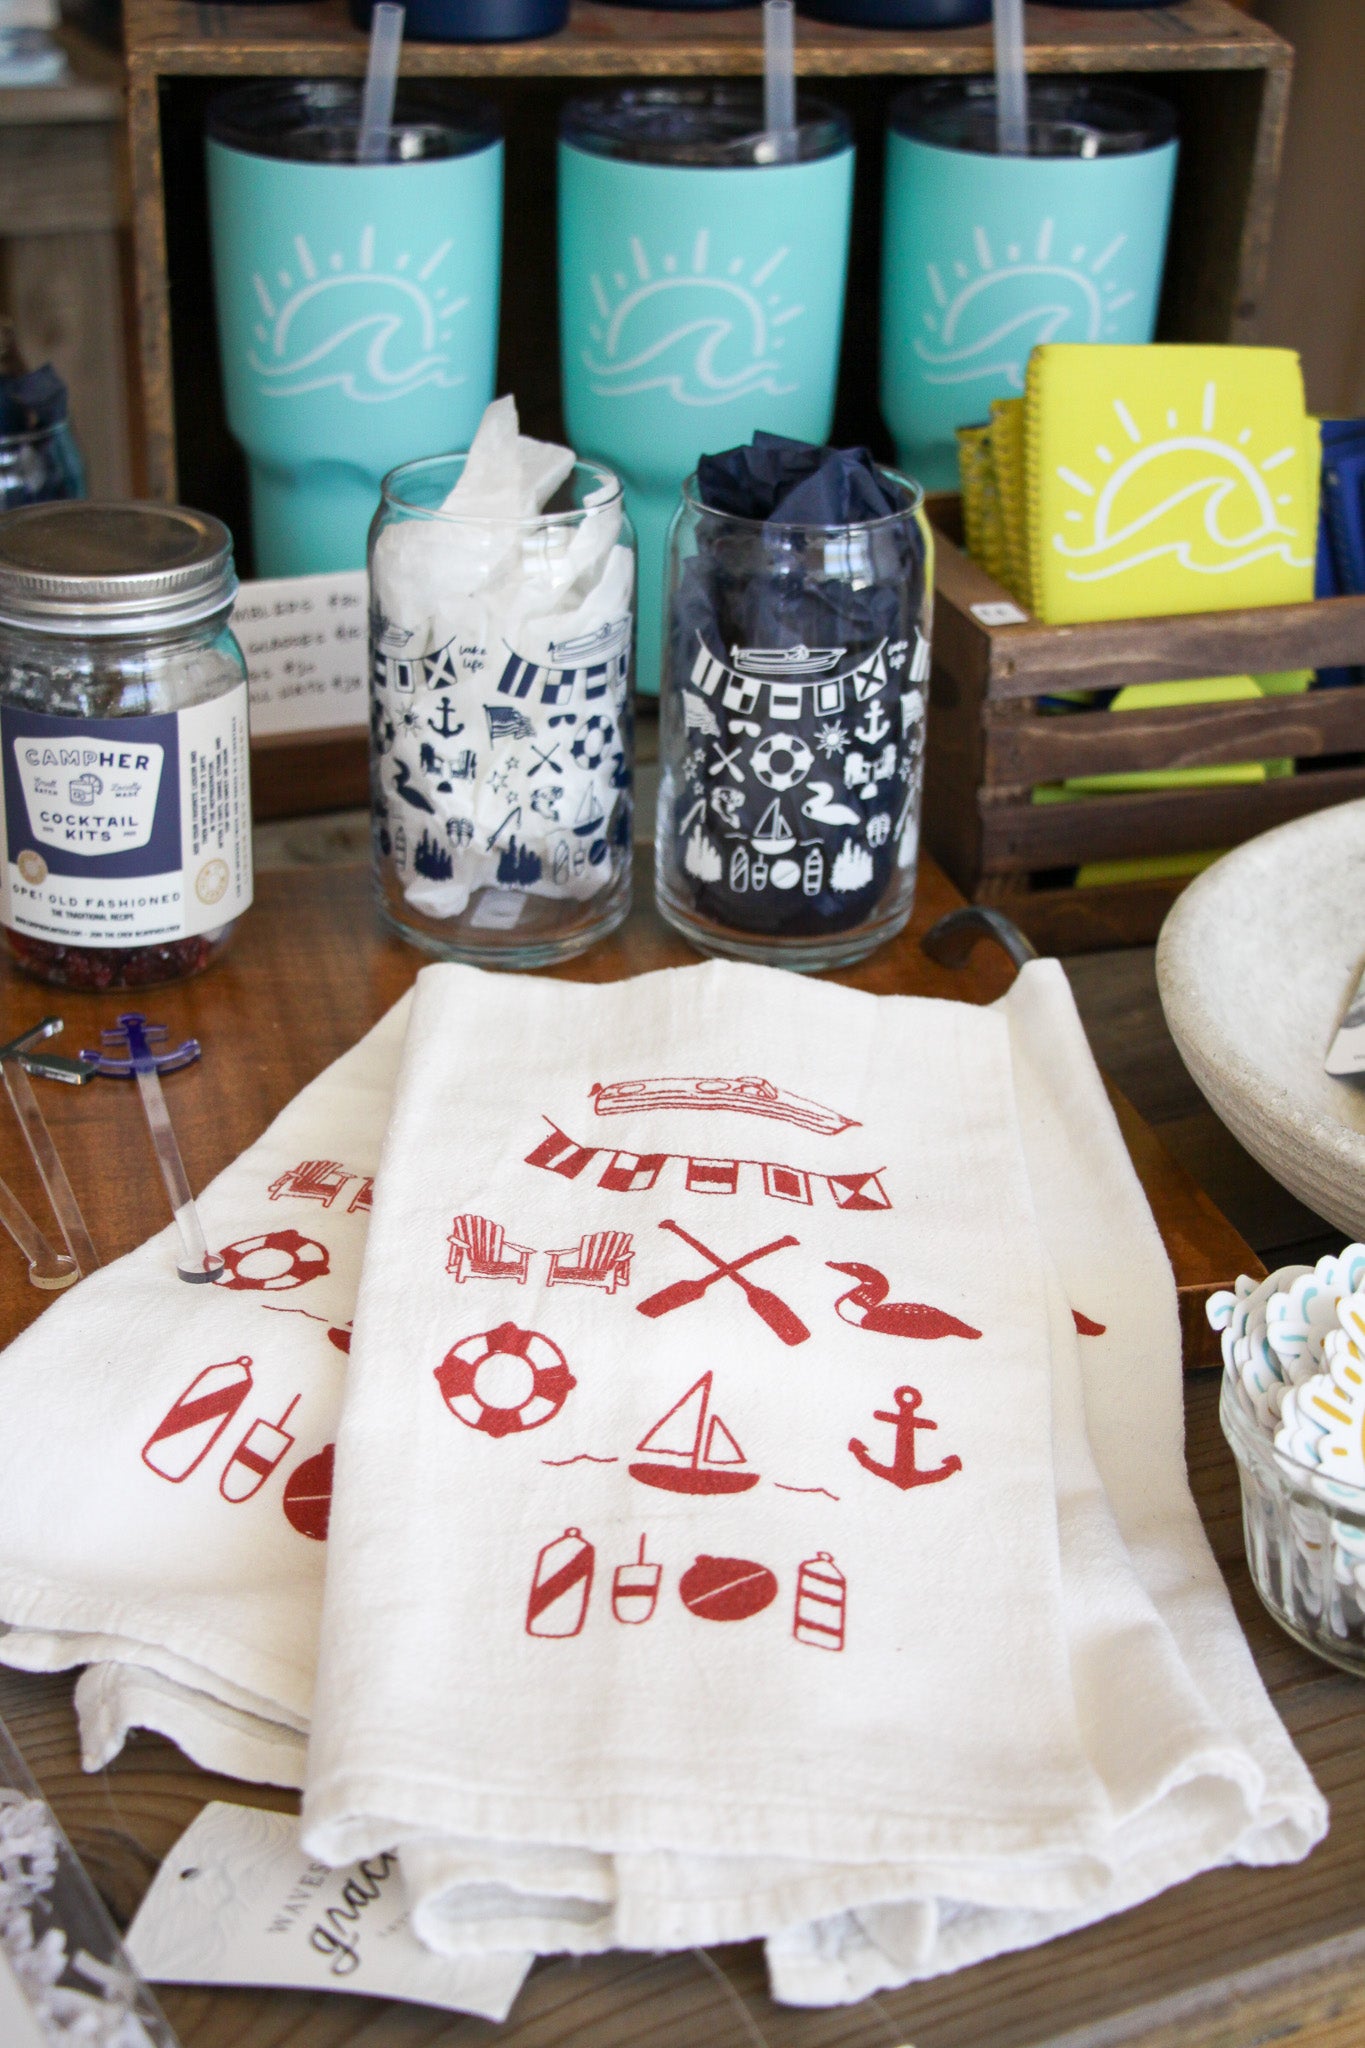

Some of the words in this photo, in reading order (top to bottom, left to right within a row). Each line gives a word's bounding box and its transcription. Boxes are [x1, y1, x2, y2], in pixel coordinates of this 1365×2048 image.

[25, 749, 150, 770] CAMPHER
[40, 811, 139, 828] COCKTAIL
[65, 829, 112, 841] KITS
[48, 894, 79, 907] OLD
[85, 892, 181, 909] FASHIONED
[267, 1862, 333, 1933] WAVES
